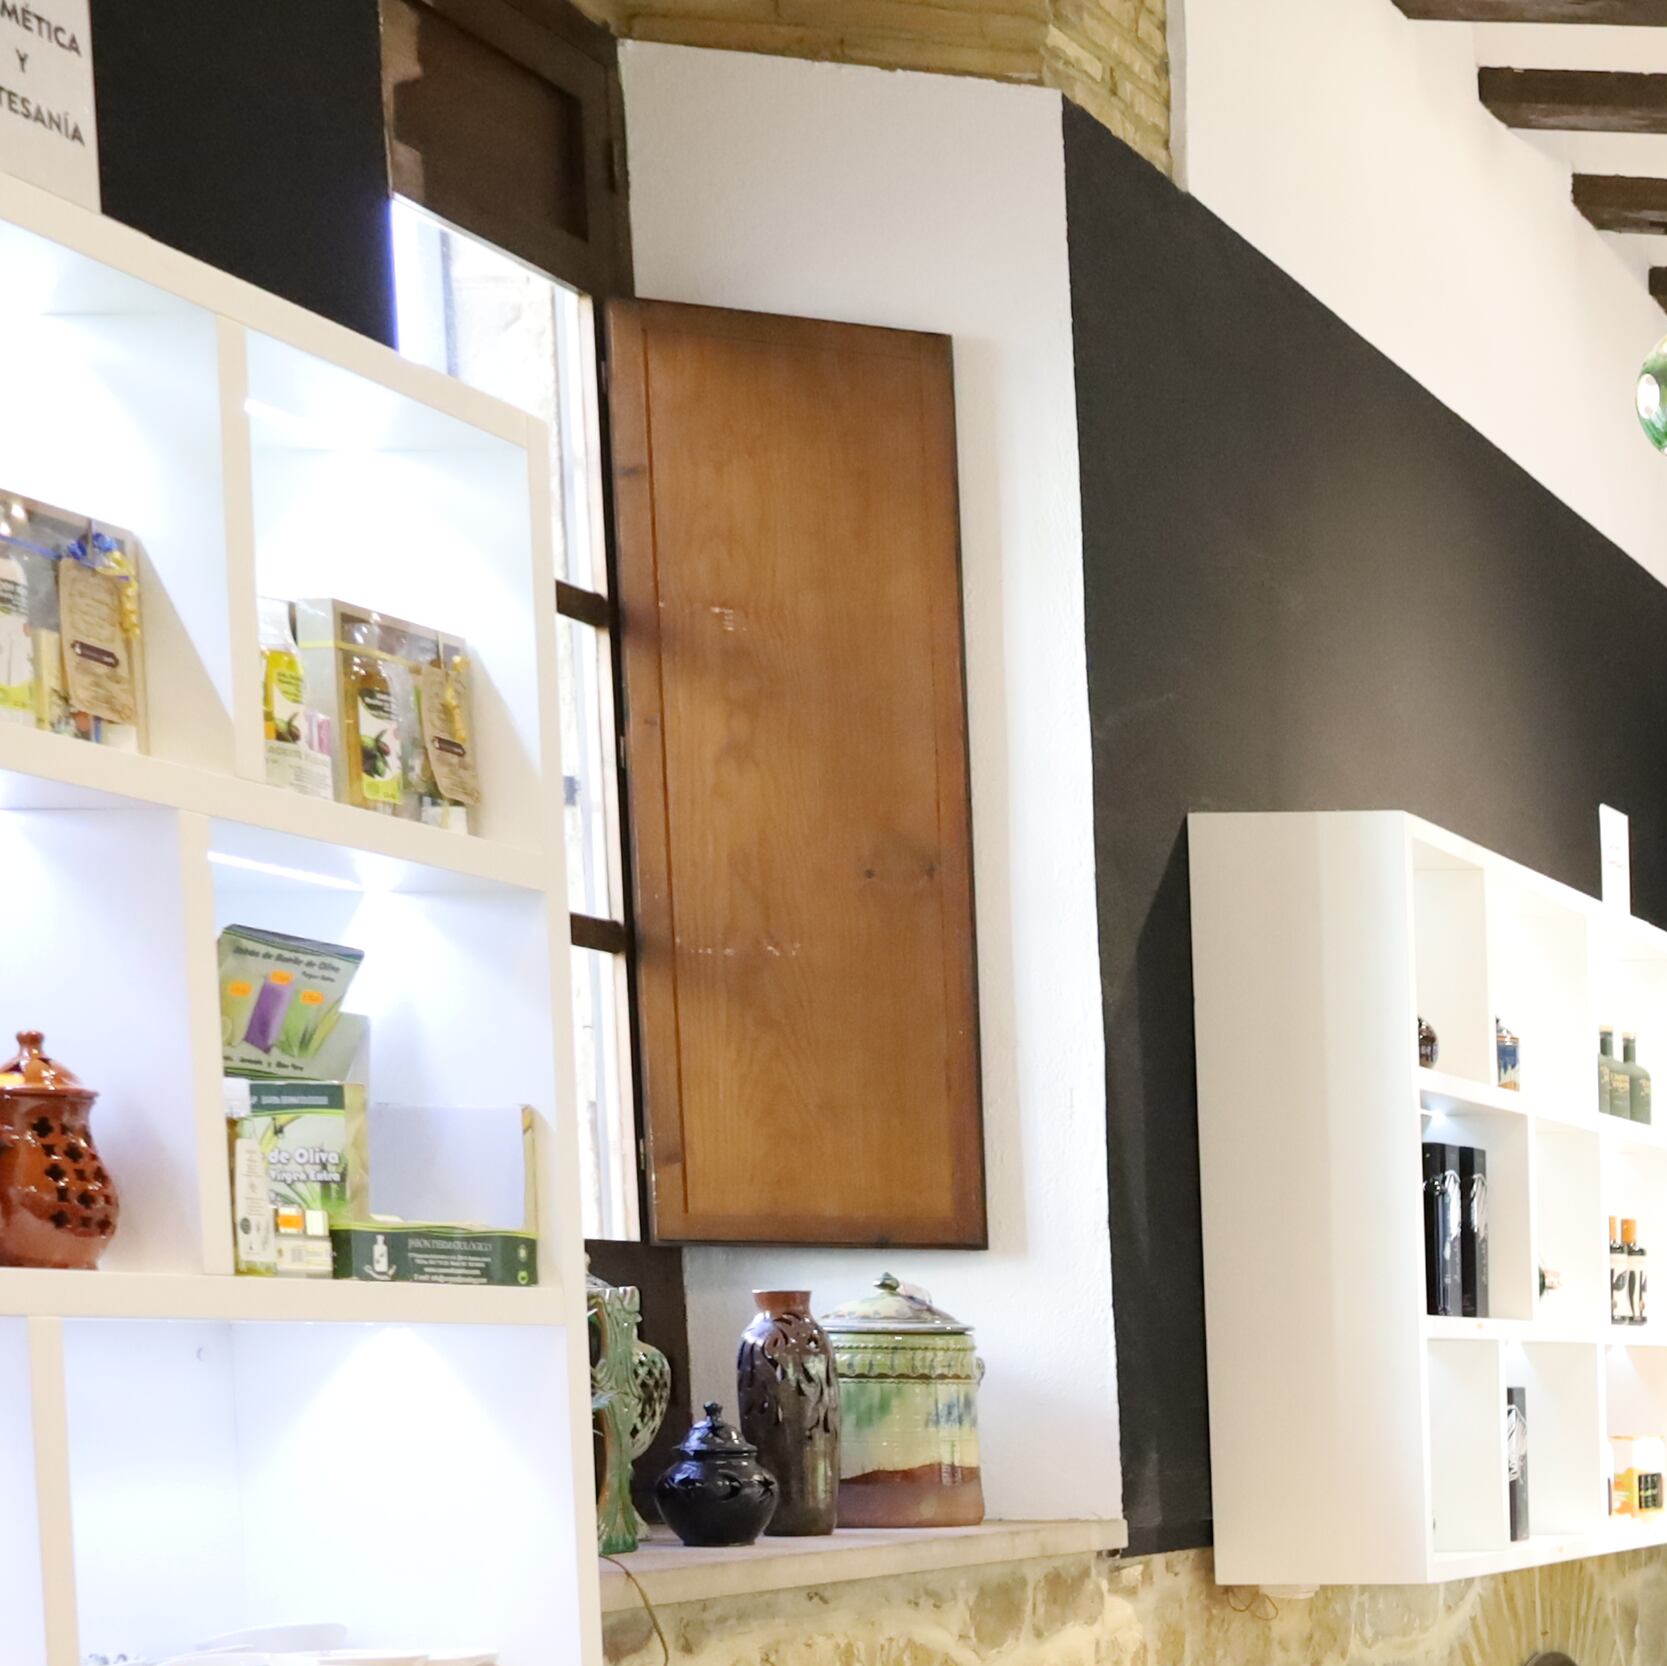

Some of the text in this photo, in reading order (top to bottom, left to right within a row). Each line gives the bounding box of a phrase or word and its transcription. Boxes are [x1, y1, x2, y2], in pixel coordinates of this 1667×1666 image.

[15, 47, 28, 73] Y
[268, 1147, 340, 1165] de Oliva
